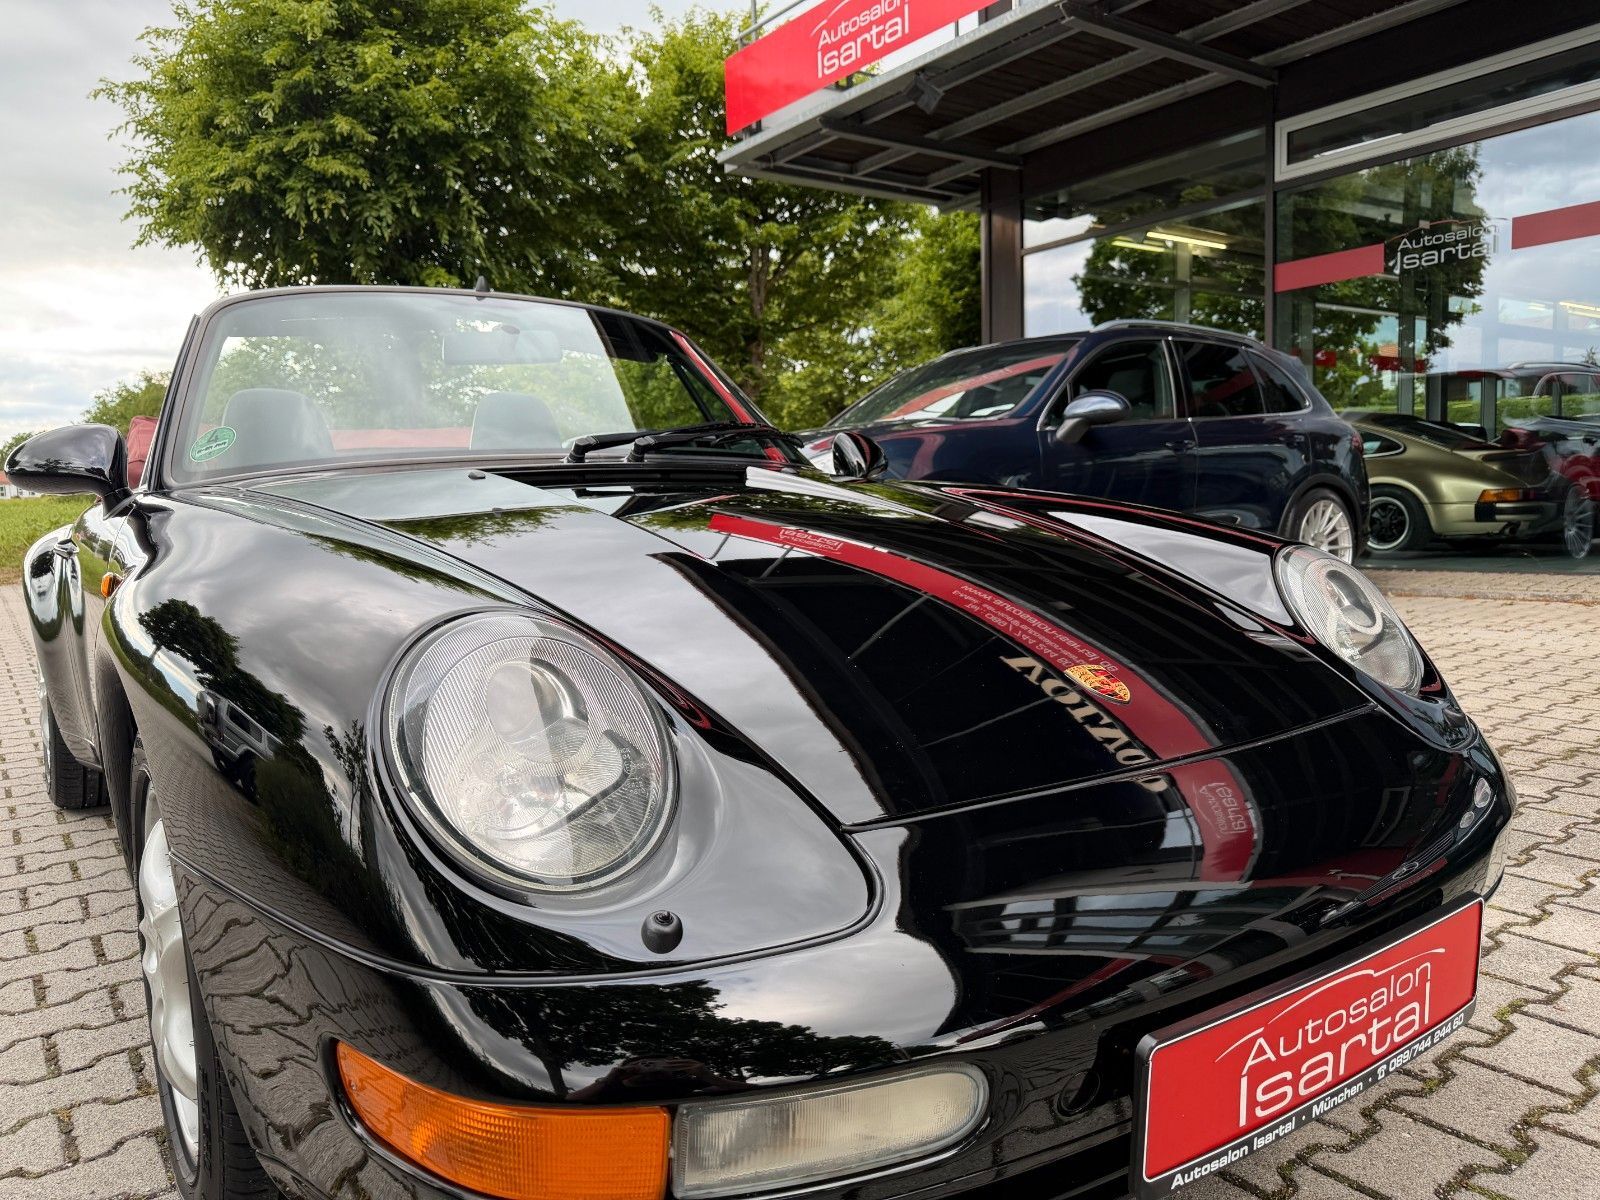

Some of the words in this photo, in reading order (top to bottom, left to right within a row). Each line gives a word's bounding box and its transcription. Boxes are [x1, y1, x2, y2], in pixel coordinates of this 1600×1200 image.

[817, 0, 909, 50] Autosalo
[817, 3, 909, 79] Isartal
[1395, 234, 1497, 275] Isartal
[1398, 225, 1498, 251] Autosalon
[1238, 979, 1432, 1128] Isartal
[1240, 960, 1432, 1076] Autosalon
[1170, 1144, 1249, 1190] Autosalon
[1253, 1116, 1296, 1151] Isartal
[1311, 1082, 1364, 1119] München
[1388, 1035, 1432, 1073] 089/744
[1433, 1021, 1452, 1044] 244
